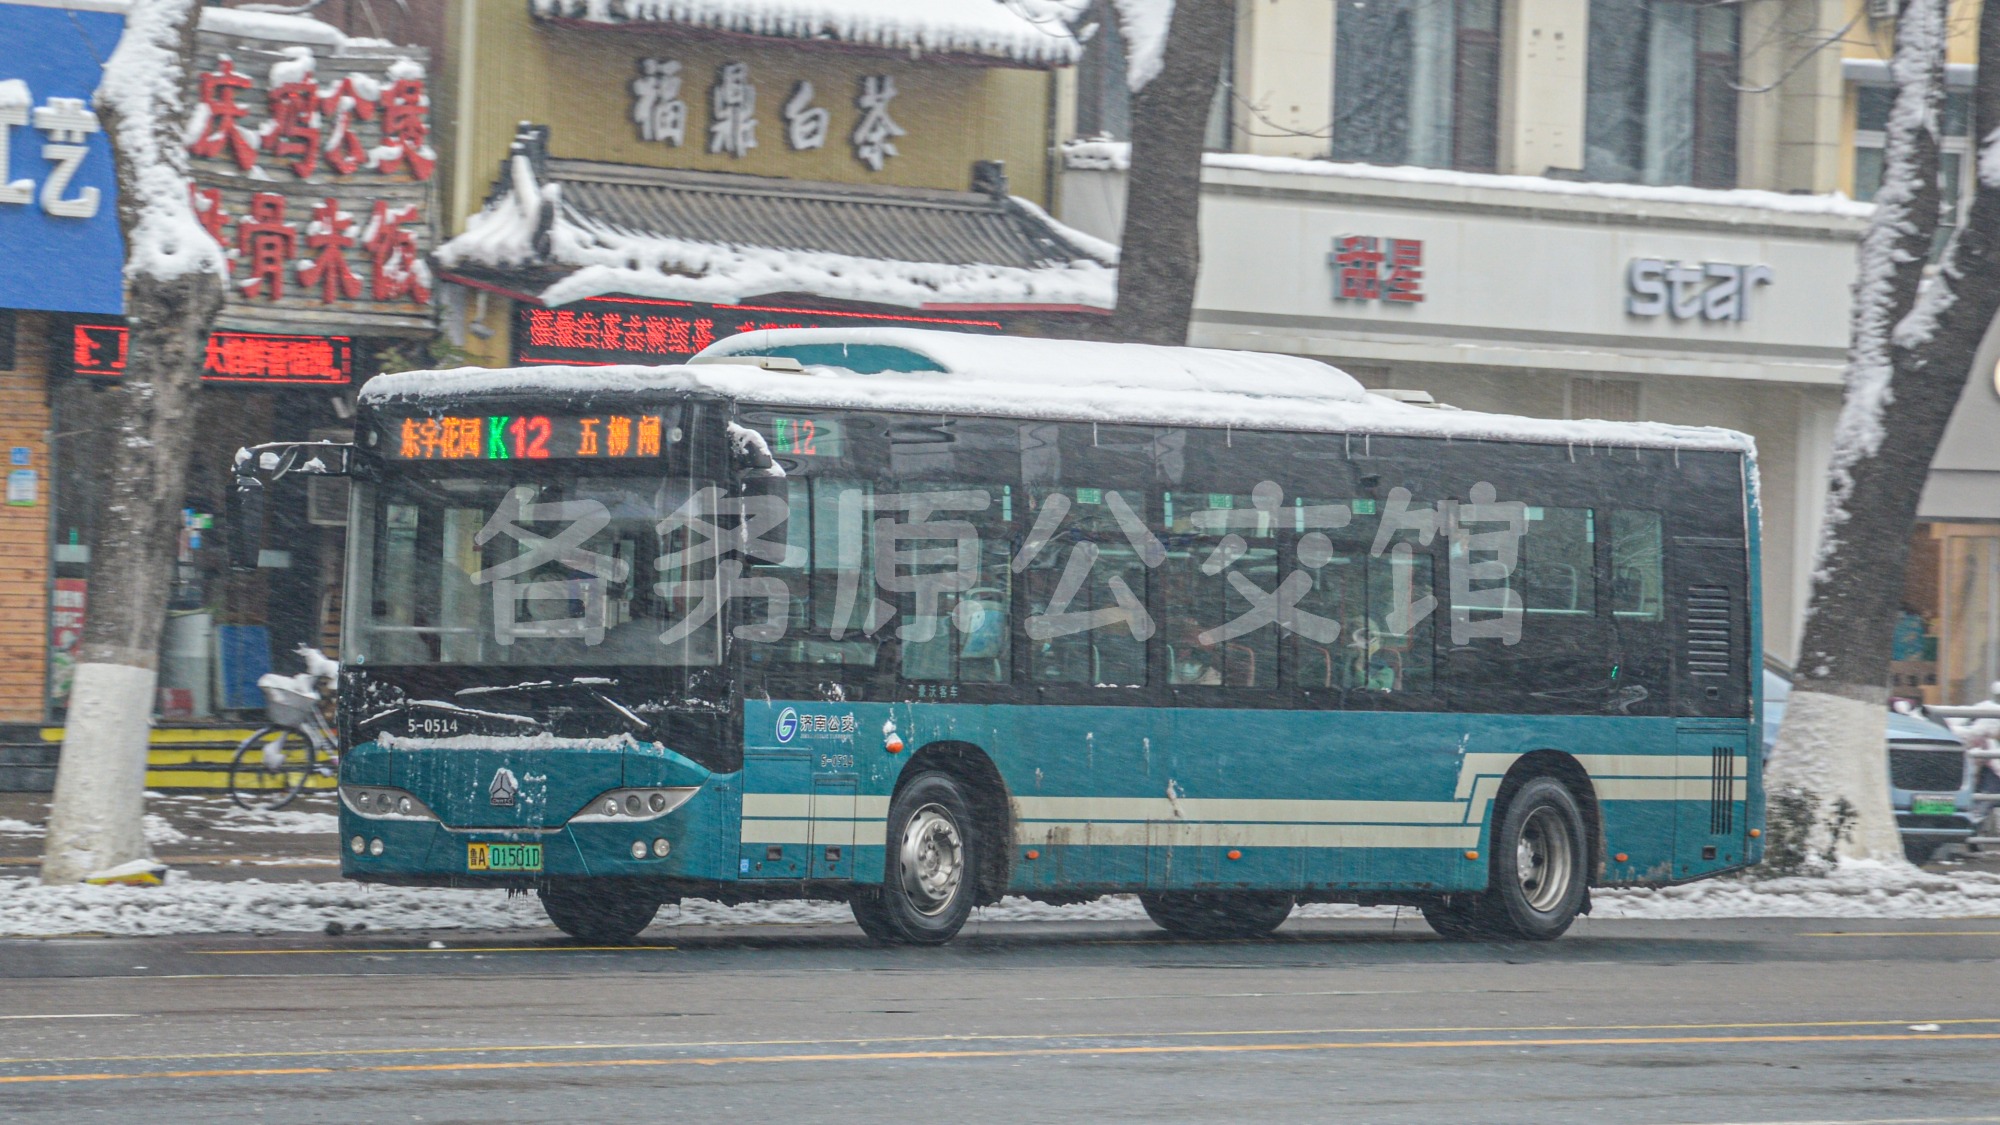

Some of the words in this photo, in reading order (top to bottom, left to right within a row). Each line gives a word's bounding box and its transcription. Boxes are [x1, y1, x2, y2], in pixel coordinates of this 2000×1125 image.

[633, 58, 907, 171] 福鼎白茶
[1628, 258, 1773, 322] star
[488, 415, 552, 459] K12
[776, 419, 816, 455] K12
[408, 718, 458, 732] 5-0514
[800, 714, 854, 732] 济南公交
